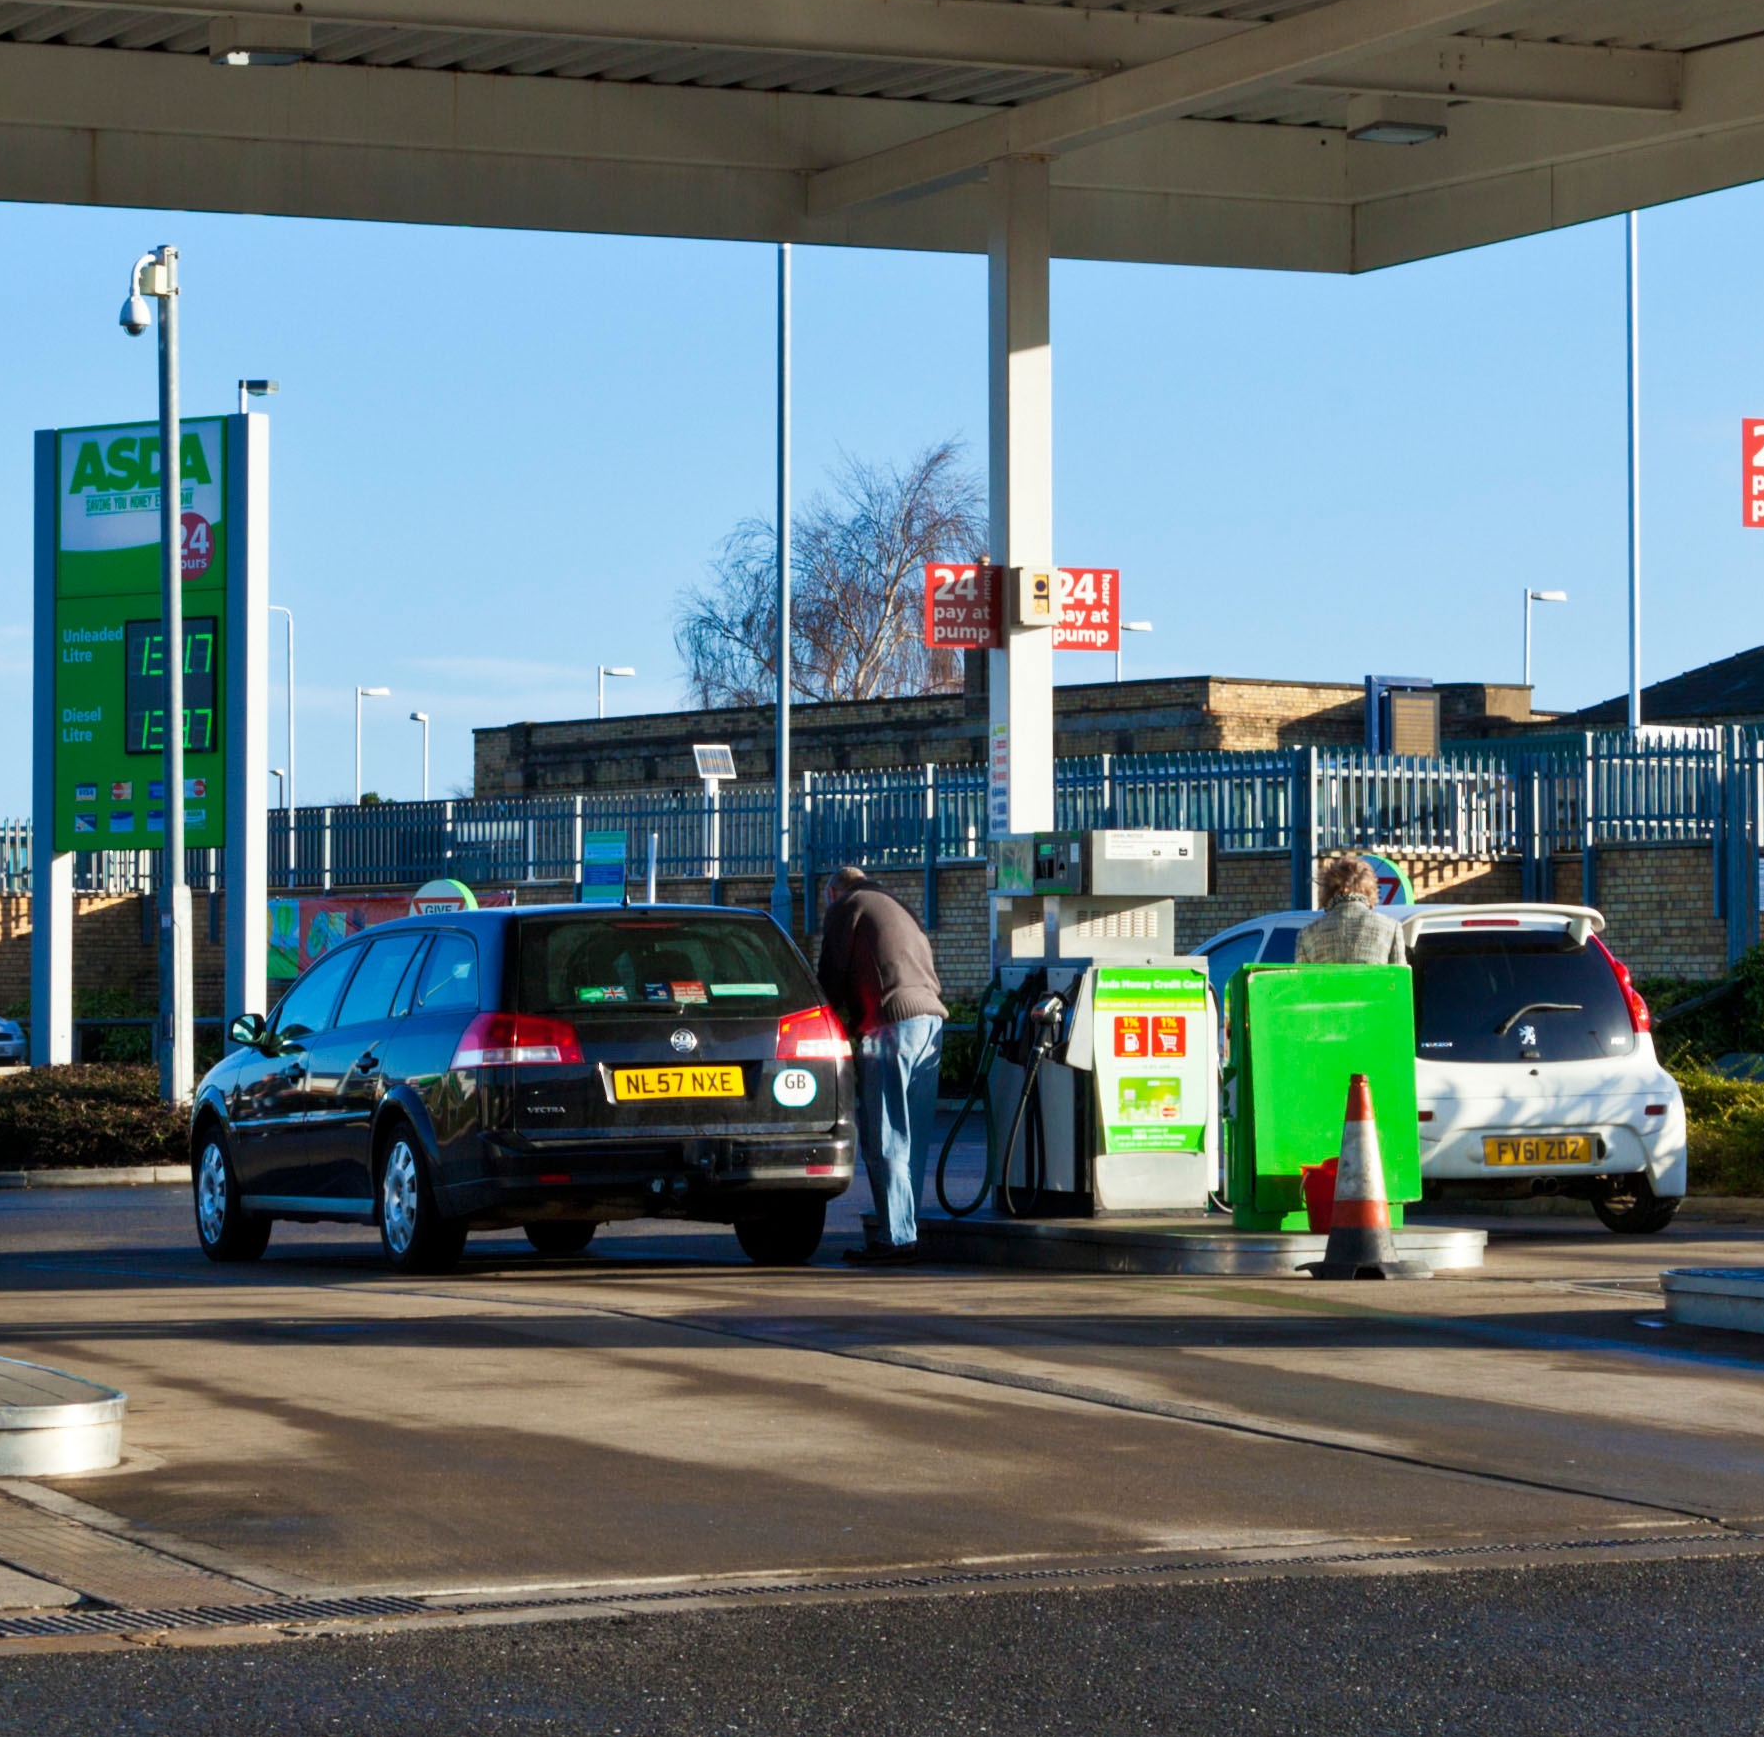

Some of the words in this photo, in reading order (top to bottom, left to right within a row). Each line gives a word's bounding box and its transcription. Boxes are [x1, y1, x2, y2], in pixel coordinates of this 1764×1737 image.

[181, 558, 207, 570] ours
[934, 568, 978, 601] 24
[984, 570, 994, 602] hour
[1101, 573, 1112, 605] hour
[934, 606, 969, 622] pay
[972, 605, 990, 620] at
[1090, 609, 1110, 623] at
[63, 627, 123, 642] Unleaded
[934, 626, 990, 644] pump
[1053, 629, 1109, 646] pump
[63, 648, 93, 663] Litre
[62, 707, 102, 722] Diesel
[62, 728, 93, 742] Litre
[425, 904, 452, 913] GIVE
[1122, 1017, 1139, 1028] 1%
[1160, 1017, 1177, 1028] 1%
[626, 1073, 683, 1094] NL57
[692, 1072, 734, 1092] NXE
[785, 1074, 806, 1090] GB
[527, 1106, 566, 1114] VECTRA
[1498, 1142, 1539, 1162] FV61
[1546, 1141, 1580, 1160] ZDZ
